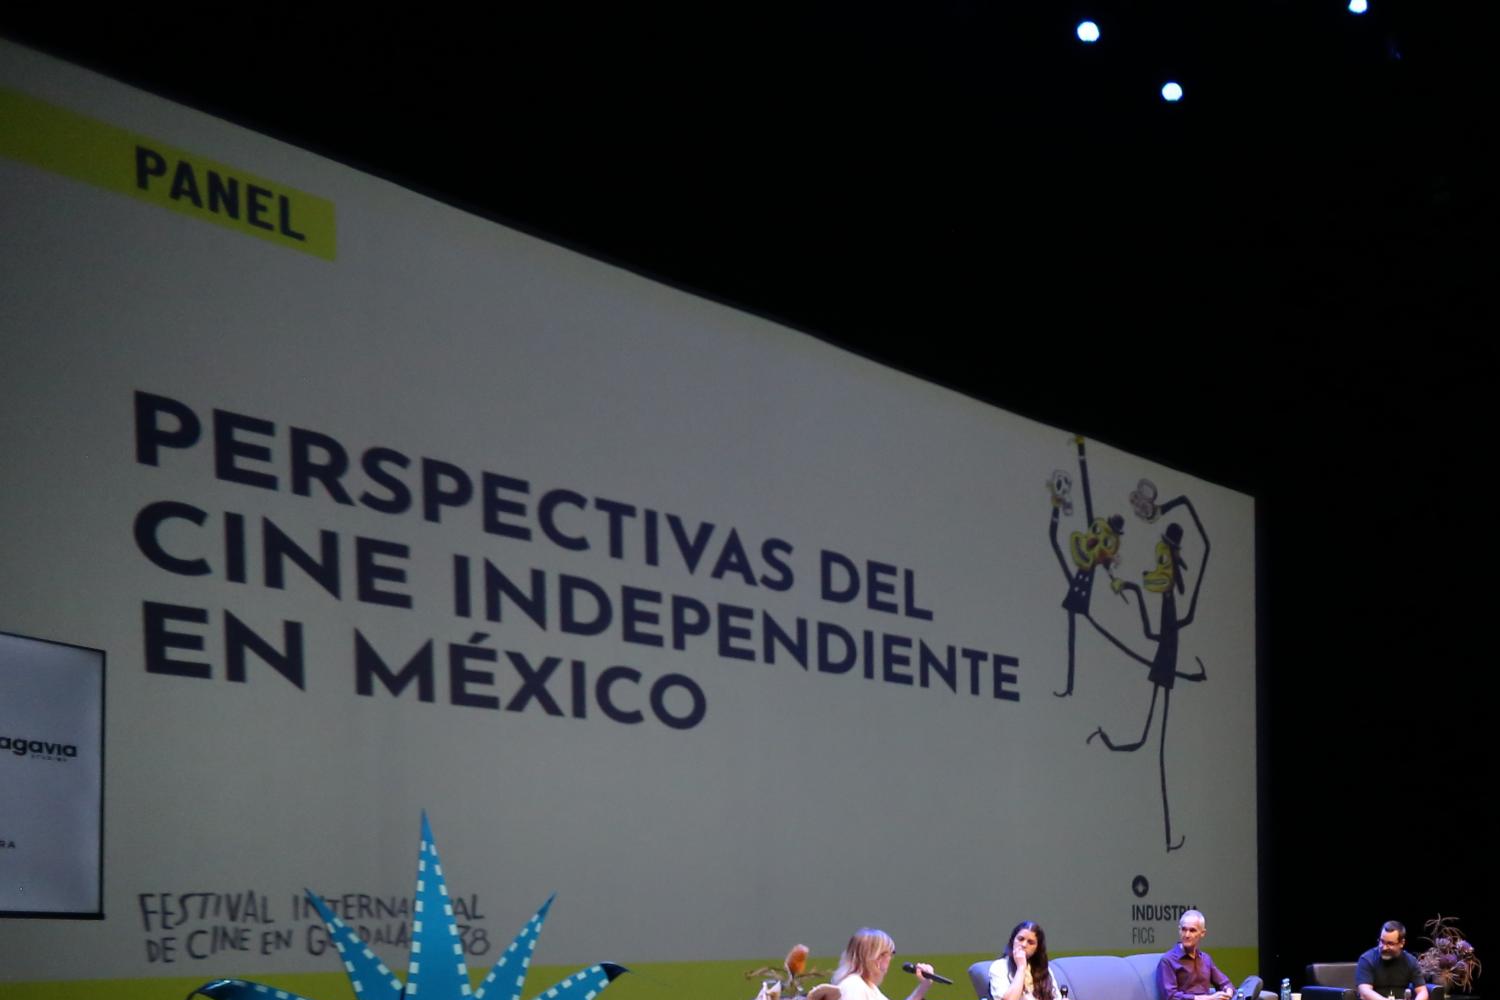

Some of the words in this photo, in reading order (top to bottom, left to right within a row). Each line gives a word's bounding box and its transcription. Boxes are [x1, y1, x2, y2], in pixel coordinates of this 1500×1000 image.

[135, 145, 306, 242] PANEL
[133, 389, 794, 592] PERSPECTIVAS
[820, 549, 934, 621] DEL
[133, 500, 413, 610] CINE
[453, 553, 1020, 702] INDEPENDIENTE
[142, 600, 306, 692] EN
[353, 626, 707, 730] MÉXICO
[138, 890, 275, 932] FESTIVAL
[293, 894, 485, 922] INTERNAAL
[146, 937, 177, 964] DE
[186, 926, 252, 960] CINE
[260, 929, 293, 955] EN
[1131, 904, 1198, 921] INDUSTR
[1132, 926, 1155, 945] FICG
